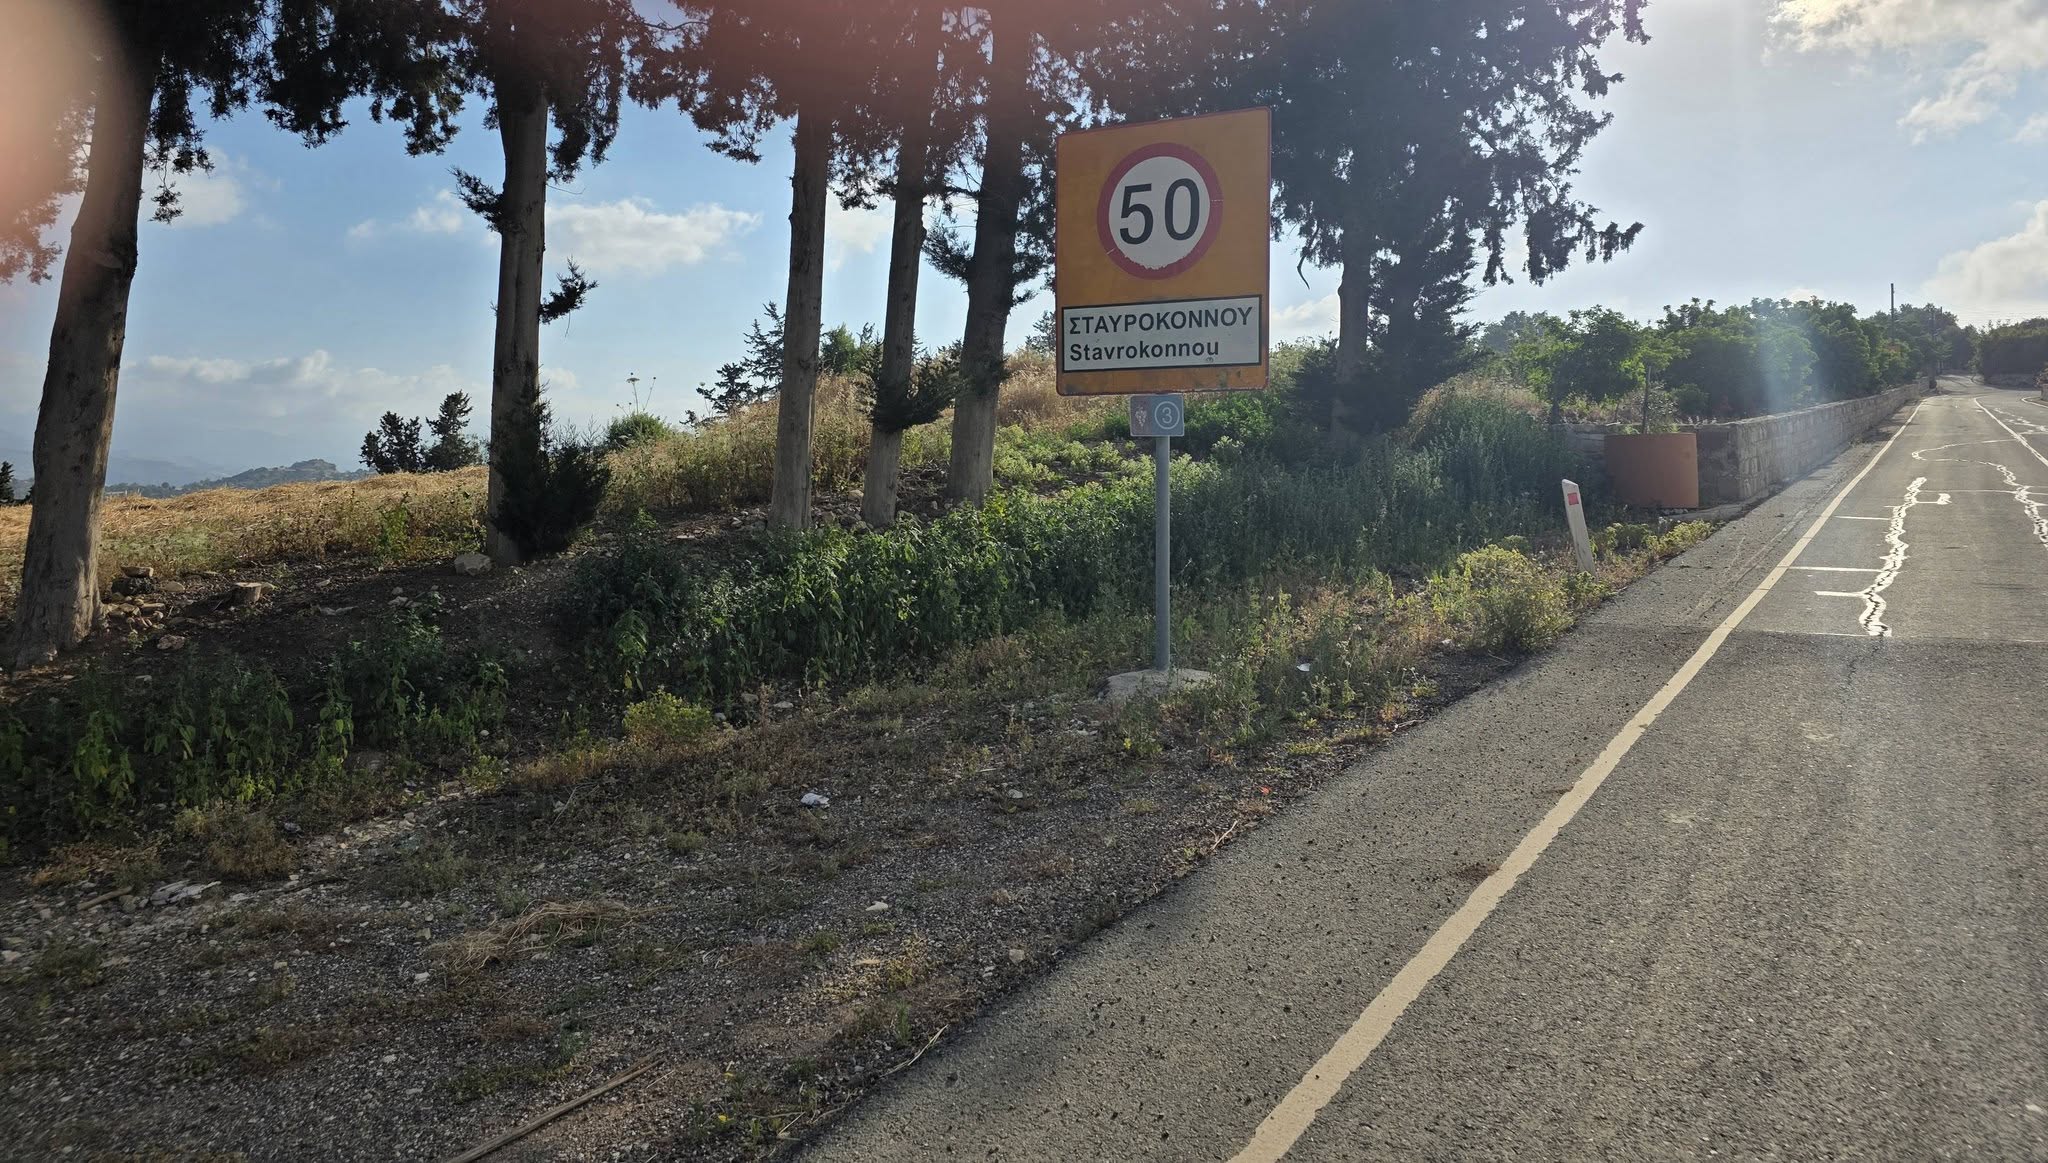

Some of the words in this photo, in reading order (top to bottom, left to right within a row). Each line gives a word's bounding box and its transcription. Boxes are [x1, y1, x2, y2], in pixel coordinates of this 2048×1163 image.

[1119, 178, 1200, 245] 50
[1069, 306, 1253, 335] ΣΤΑΥΡΟΚΟΝΝΟΥ
[1070, 341, 1219, 362] Stavrokonnou
[1162, 407, 1173, 424] 3
